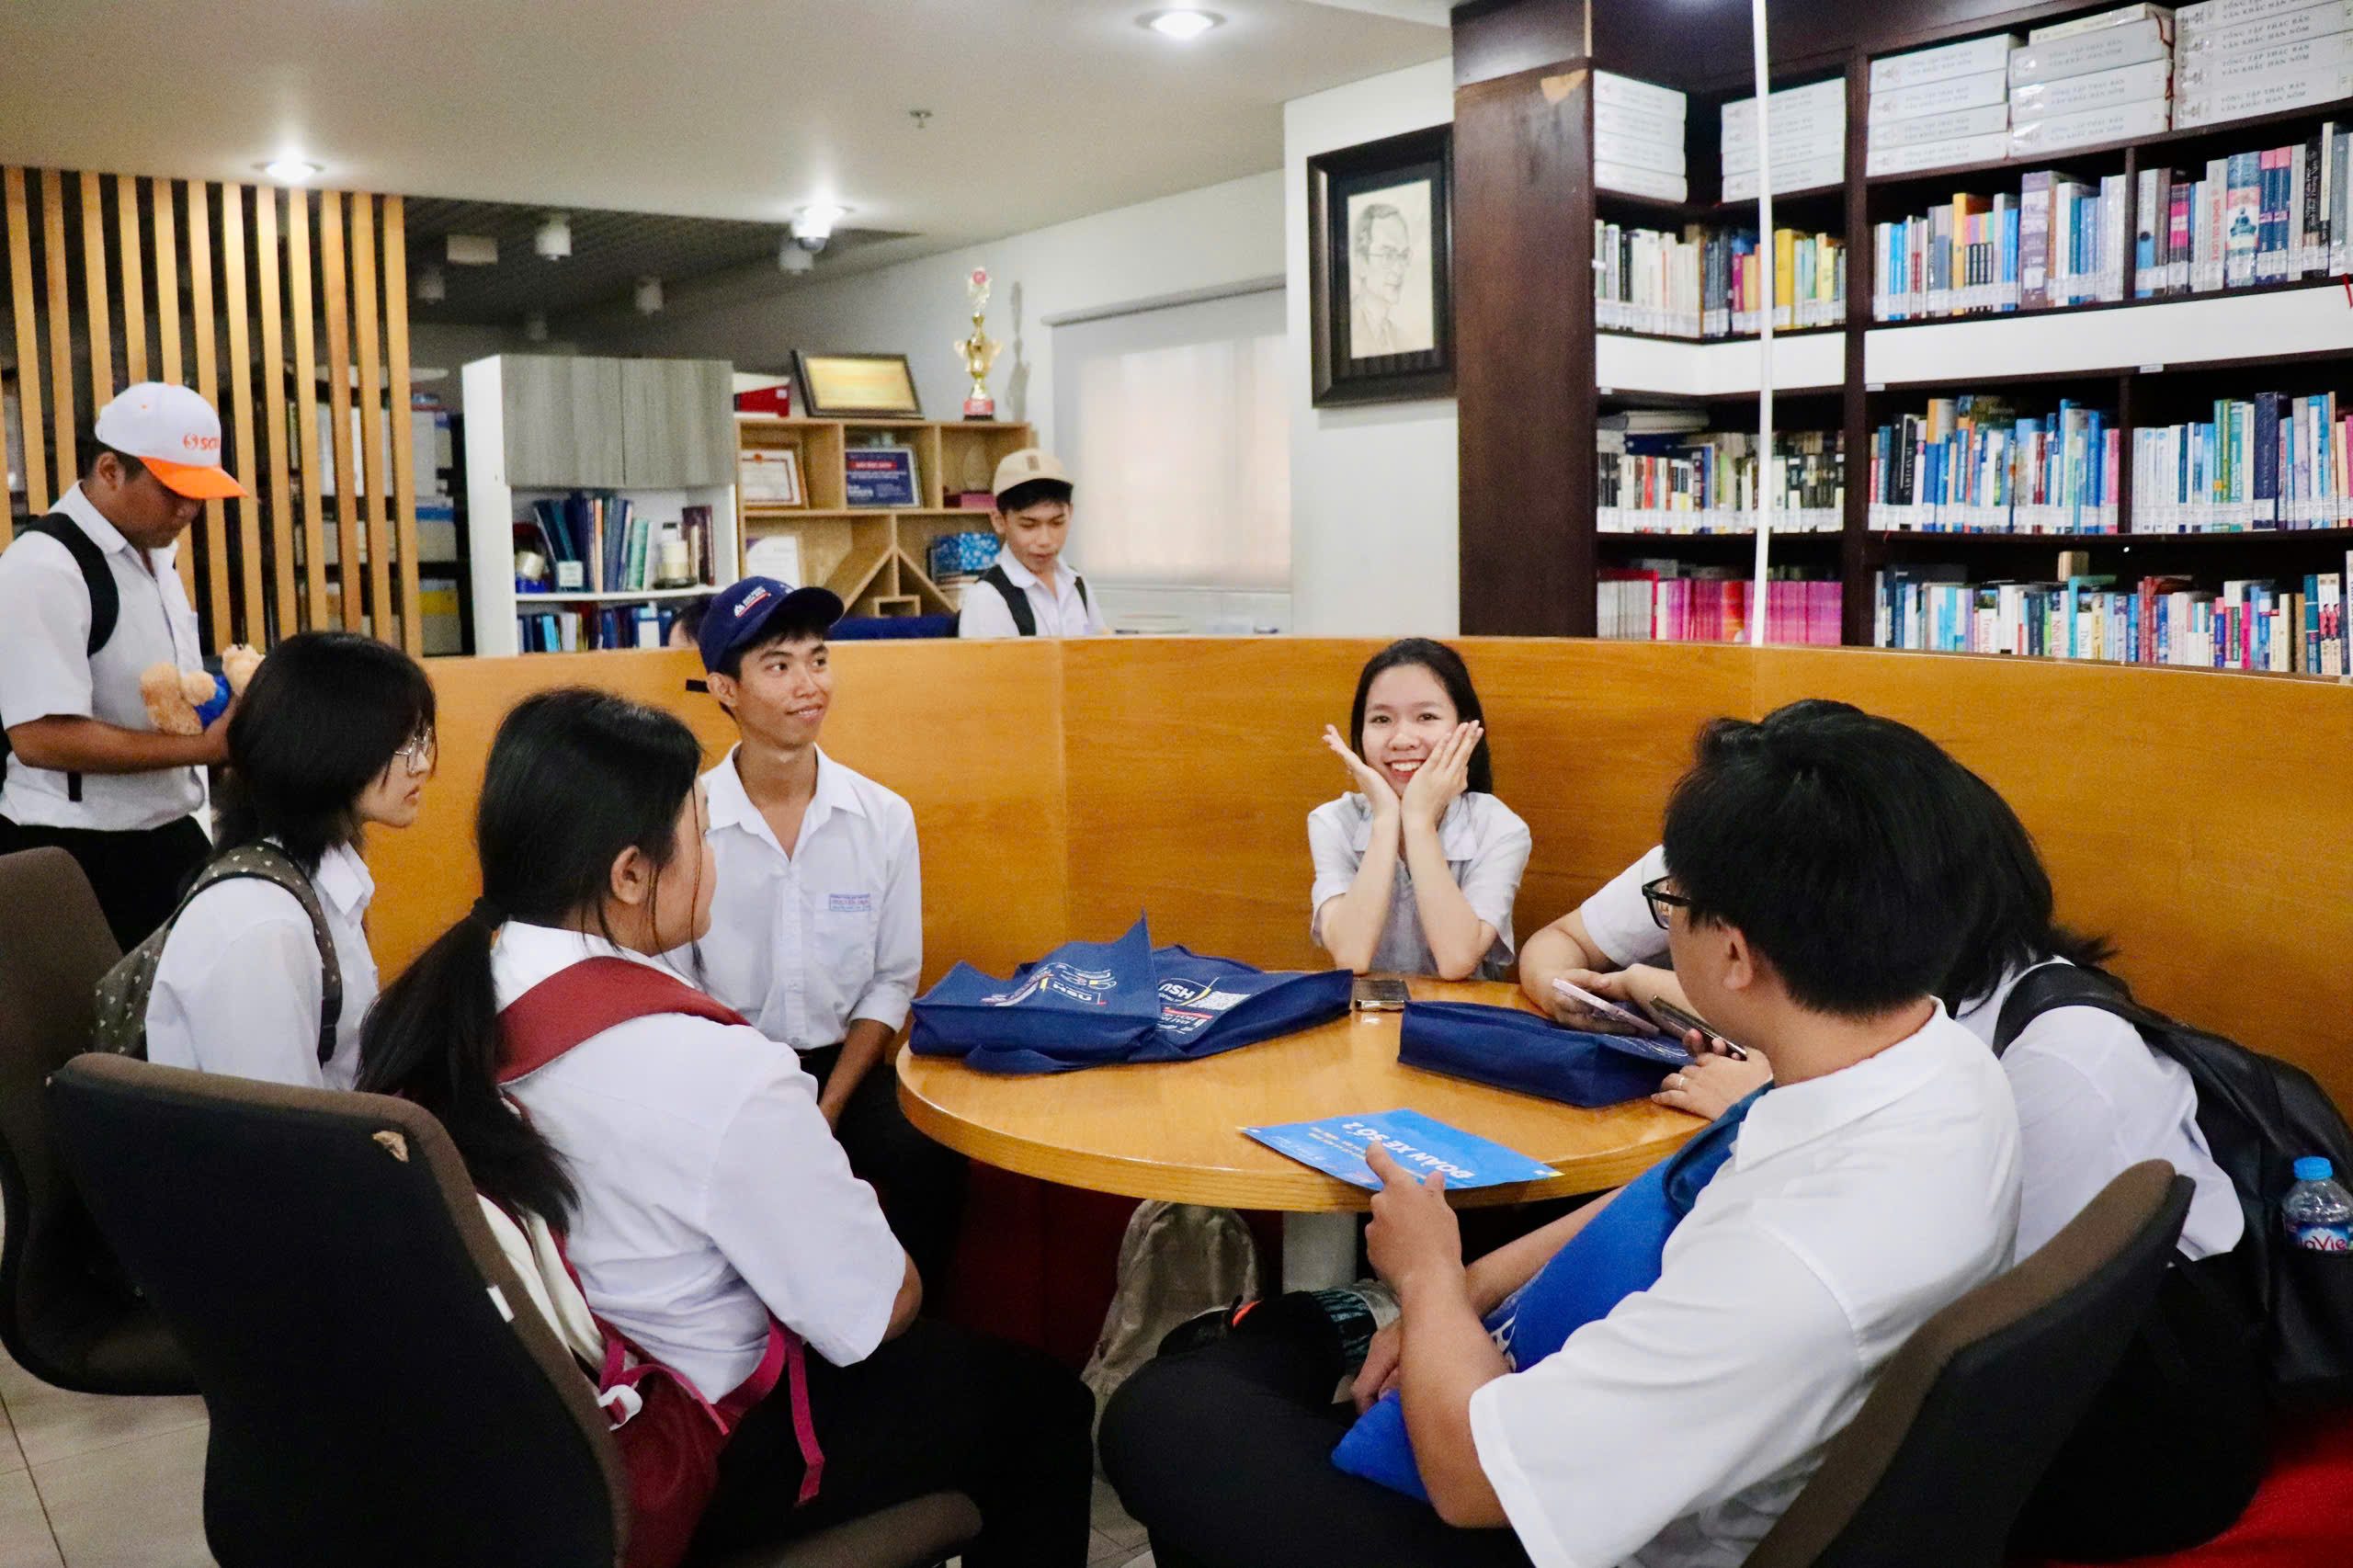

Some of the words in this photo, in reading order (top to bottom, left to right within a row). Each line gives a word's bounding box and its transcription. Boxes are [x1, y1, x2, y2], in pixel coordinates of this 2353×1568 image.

[1158, 983, 1196, 999] HSU
[1381, 1140, 1418, 1153] XE
[1405, 1152, 1476, 1179] ĐOÀN
